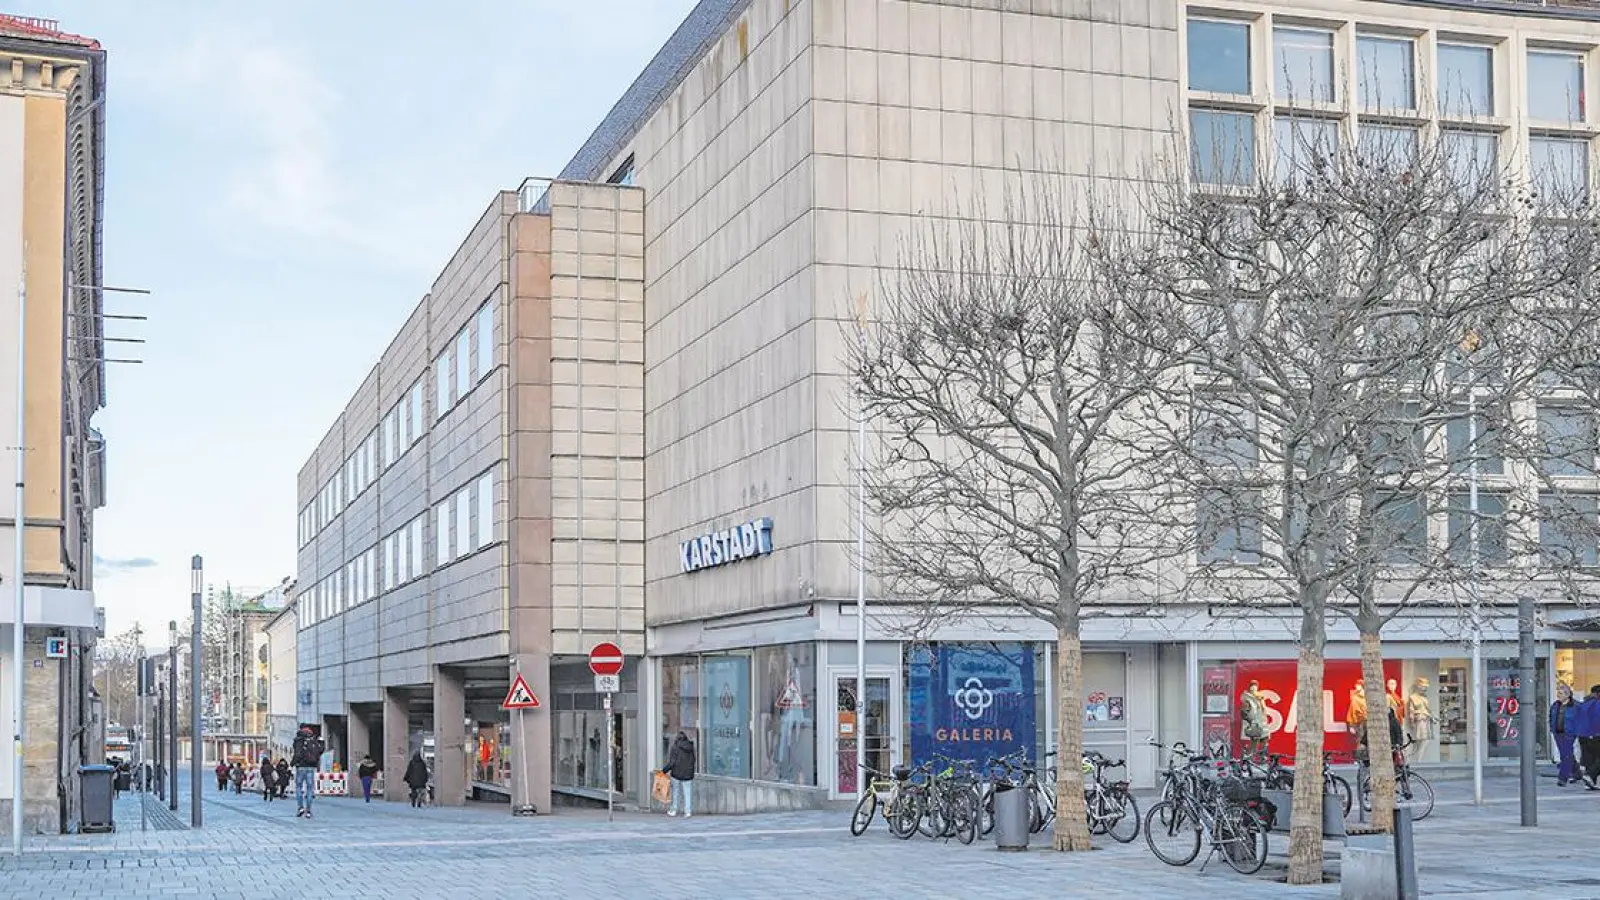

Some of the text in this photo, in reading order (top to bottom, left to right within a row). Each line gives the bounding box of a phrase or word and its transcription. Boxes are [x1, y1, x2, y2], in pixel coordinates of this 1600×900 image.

[679, 518, 773, 572] KARSTADT
[1496, 697, 1519, 716] 70
[936, 728, 1013, 742] GALERIA
